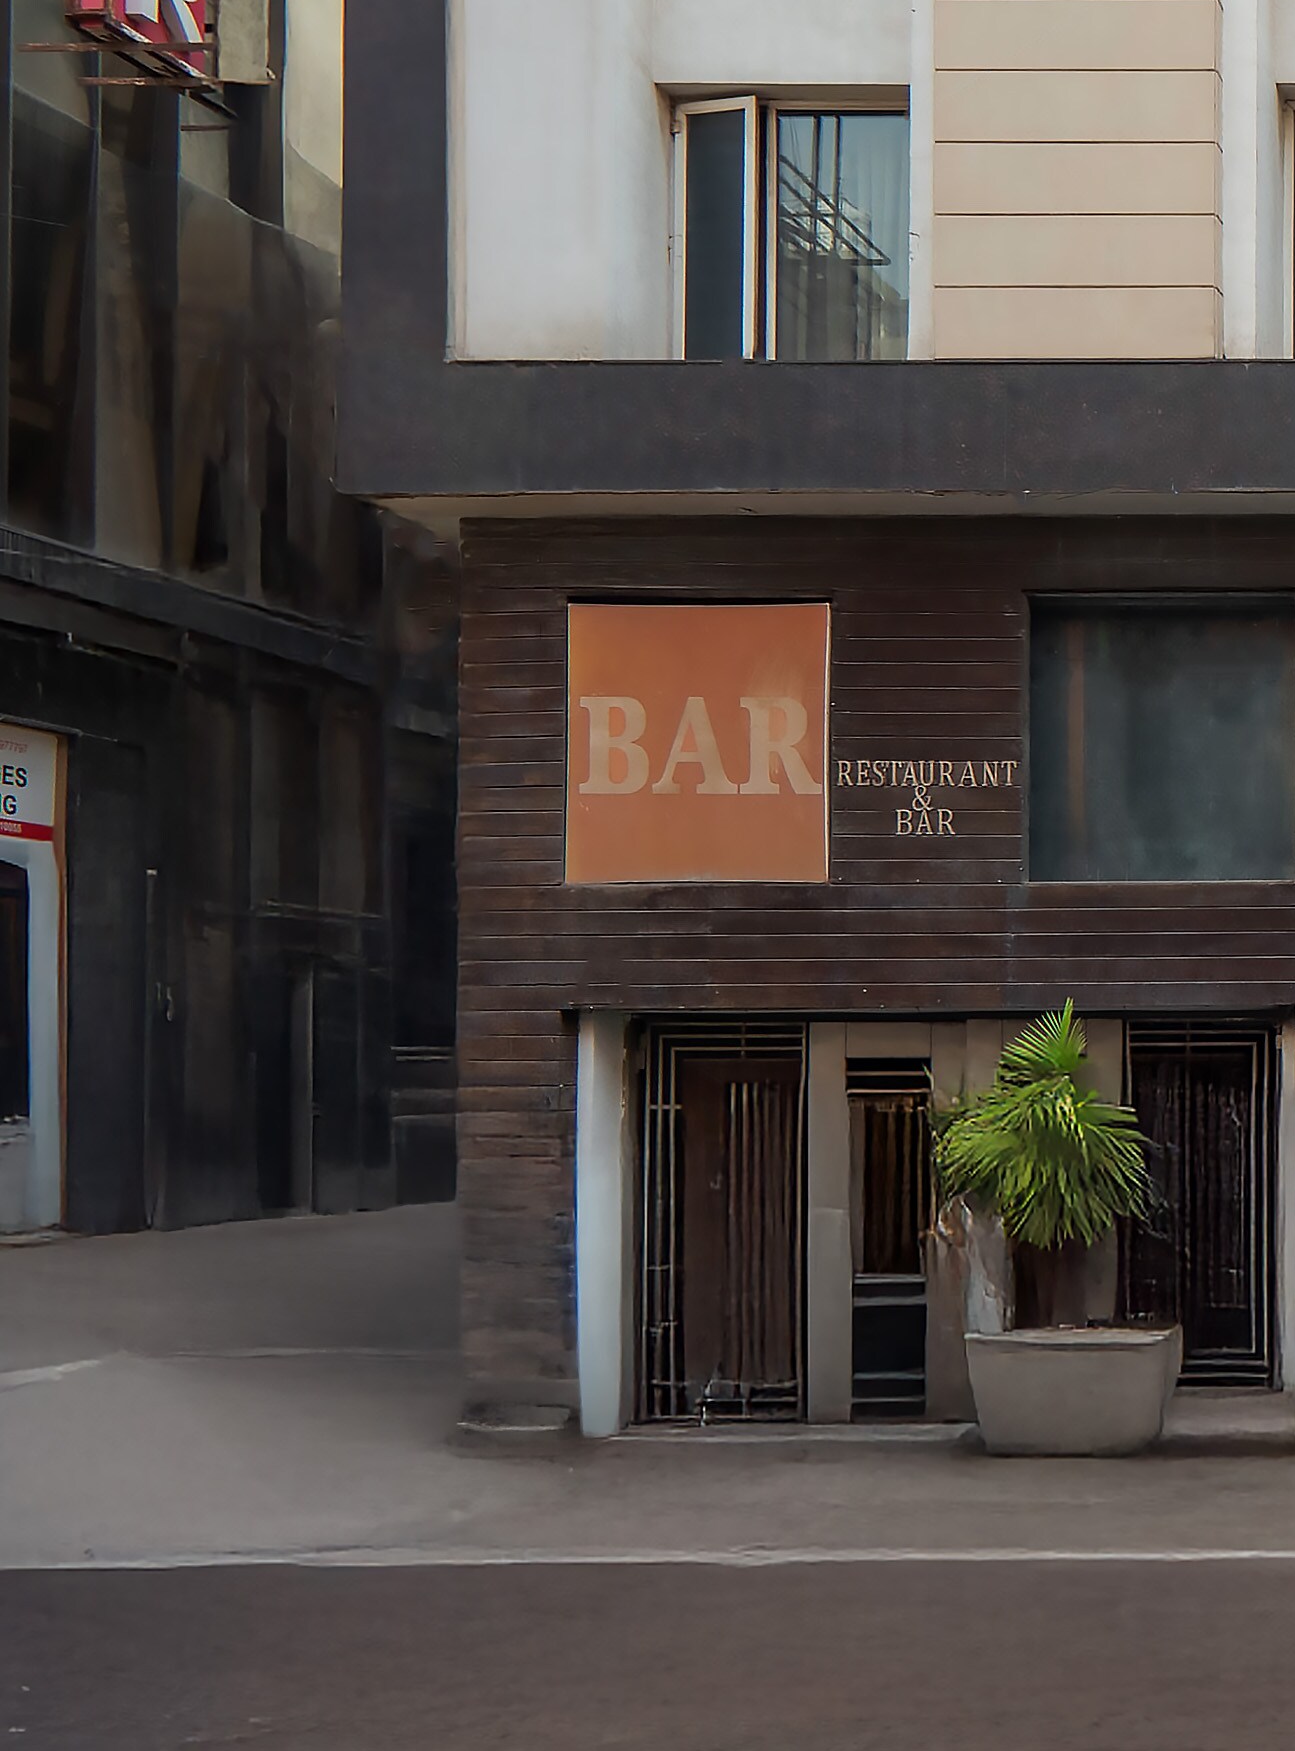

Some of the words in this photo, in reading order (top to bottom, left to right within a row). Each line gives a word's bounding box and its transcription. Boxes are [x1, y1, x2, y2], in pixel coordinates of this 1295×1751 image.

[579, 696, 822, 795] BAR
[0, 764, 28, 788] ES
[837, 760, 1017, 788] RESTAURANT
[911, 786, 932, 811] &
[896, 809, 956, 836] BAR
